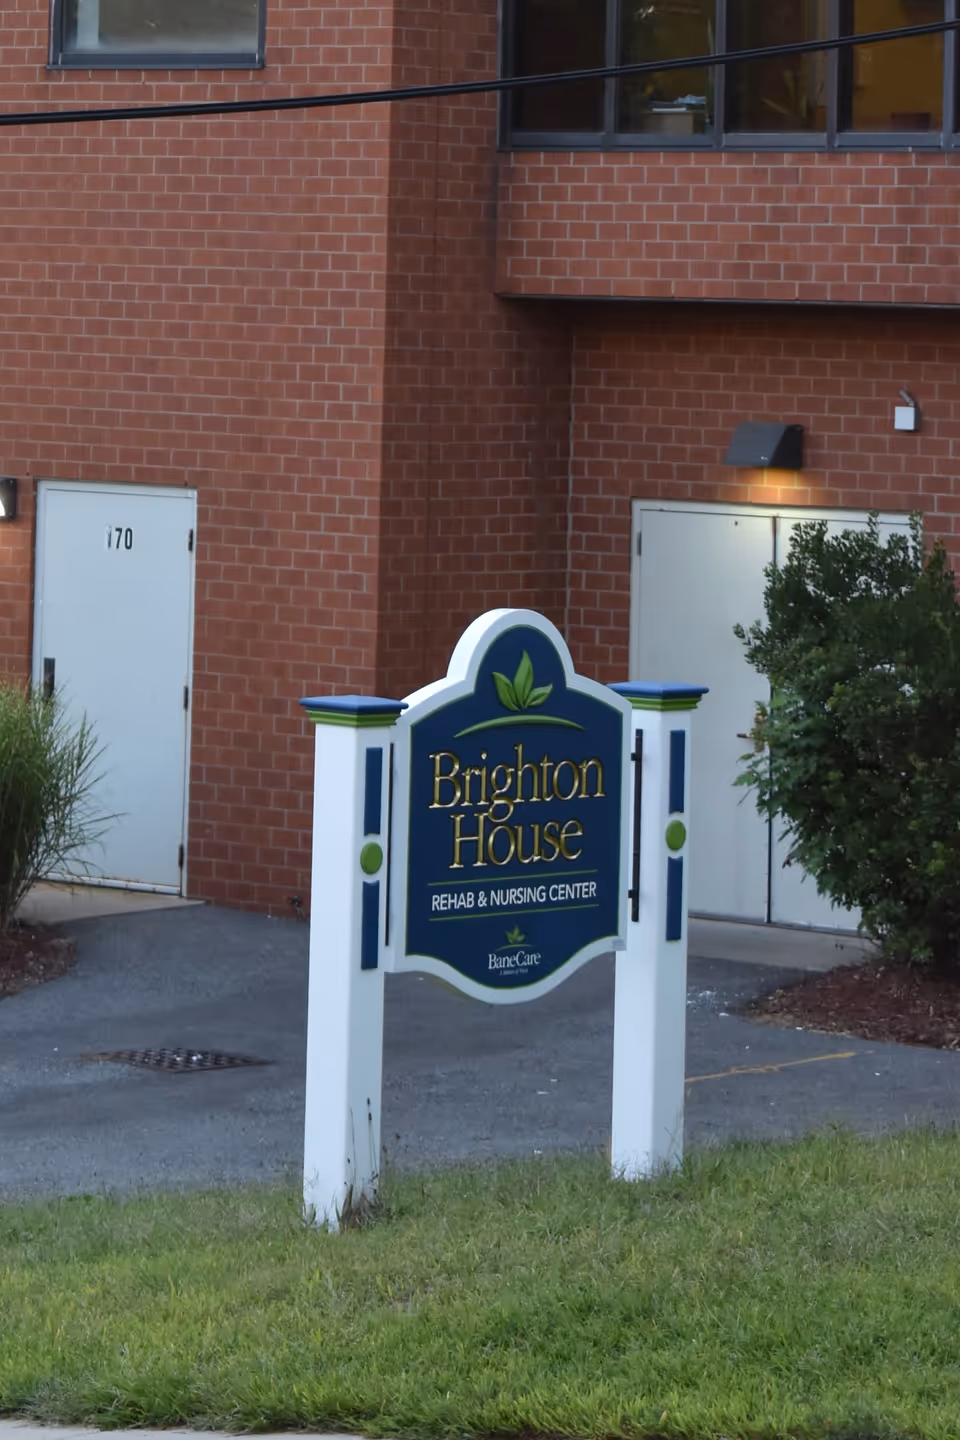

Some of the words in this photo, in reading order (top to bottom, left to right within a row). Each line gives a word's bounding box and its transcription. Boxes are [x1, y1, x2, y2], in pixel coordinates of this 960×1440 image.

[106, 525, 133, 550] 170
[428, 744, 605, 822] Brighton
[449, 812, 583, 868] House
[431, 891, 475, 911] REHAB
[477, 891, 488, 907] &
[490, 886, 546, 906] NURSING
[549, 882, 597, 900] CENTER
[488, 951, 541, 969] BaneCare
